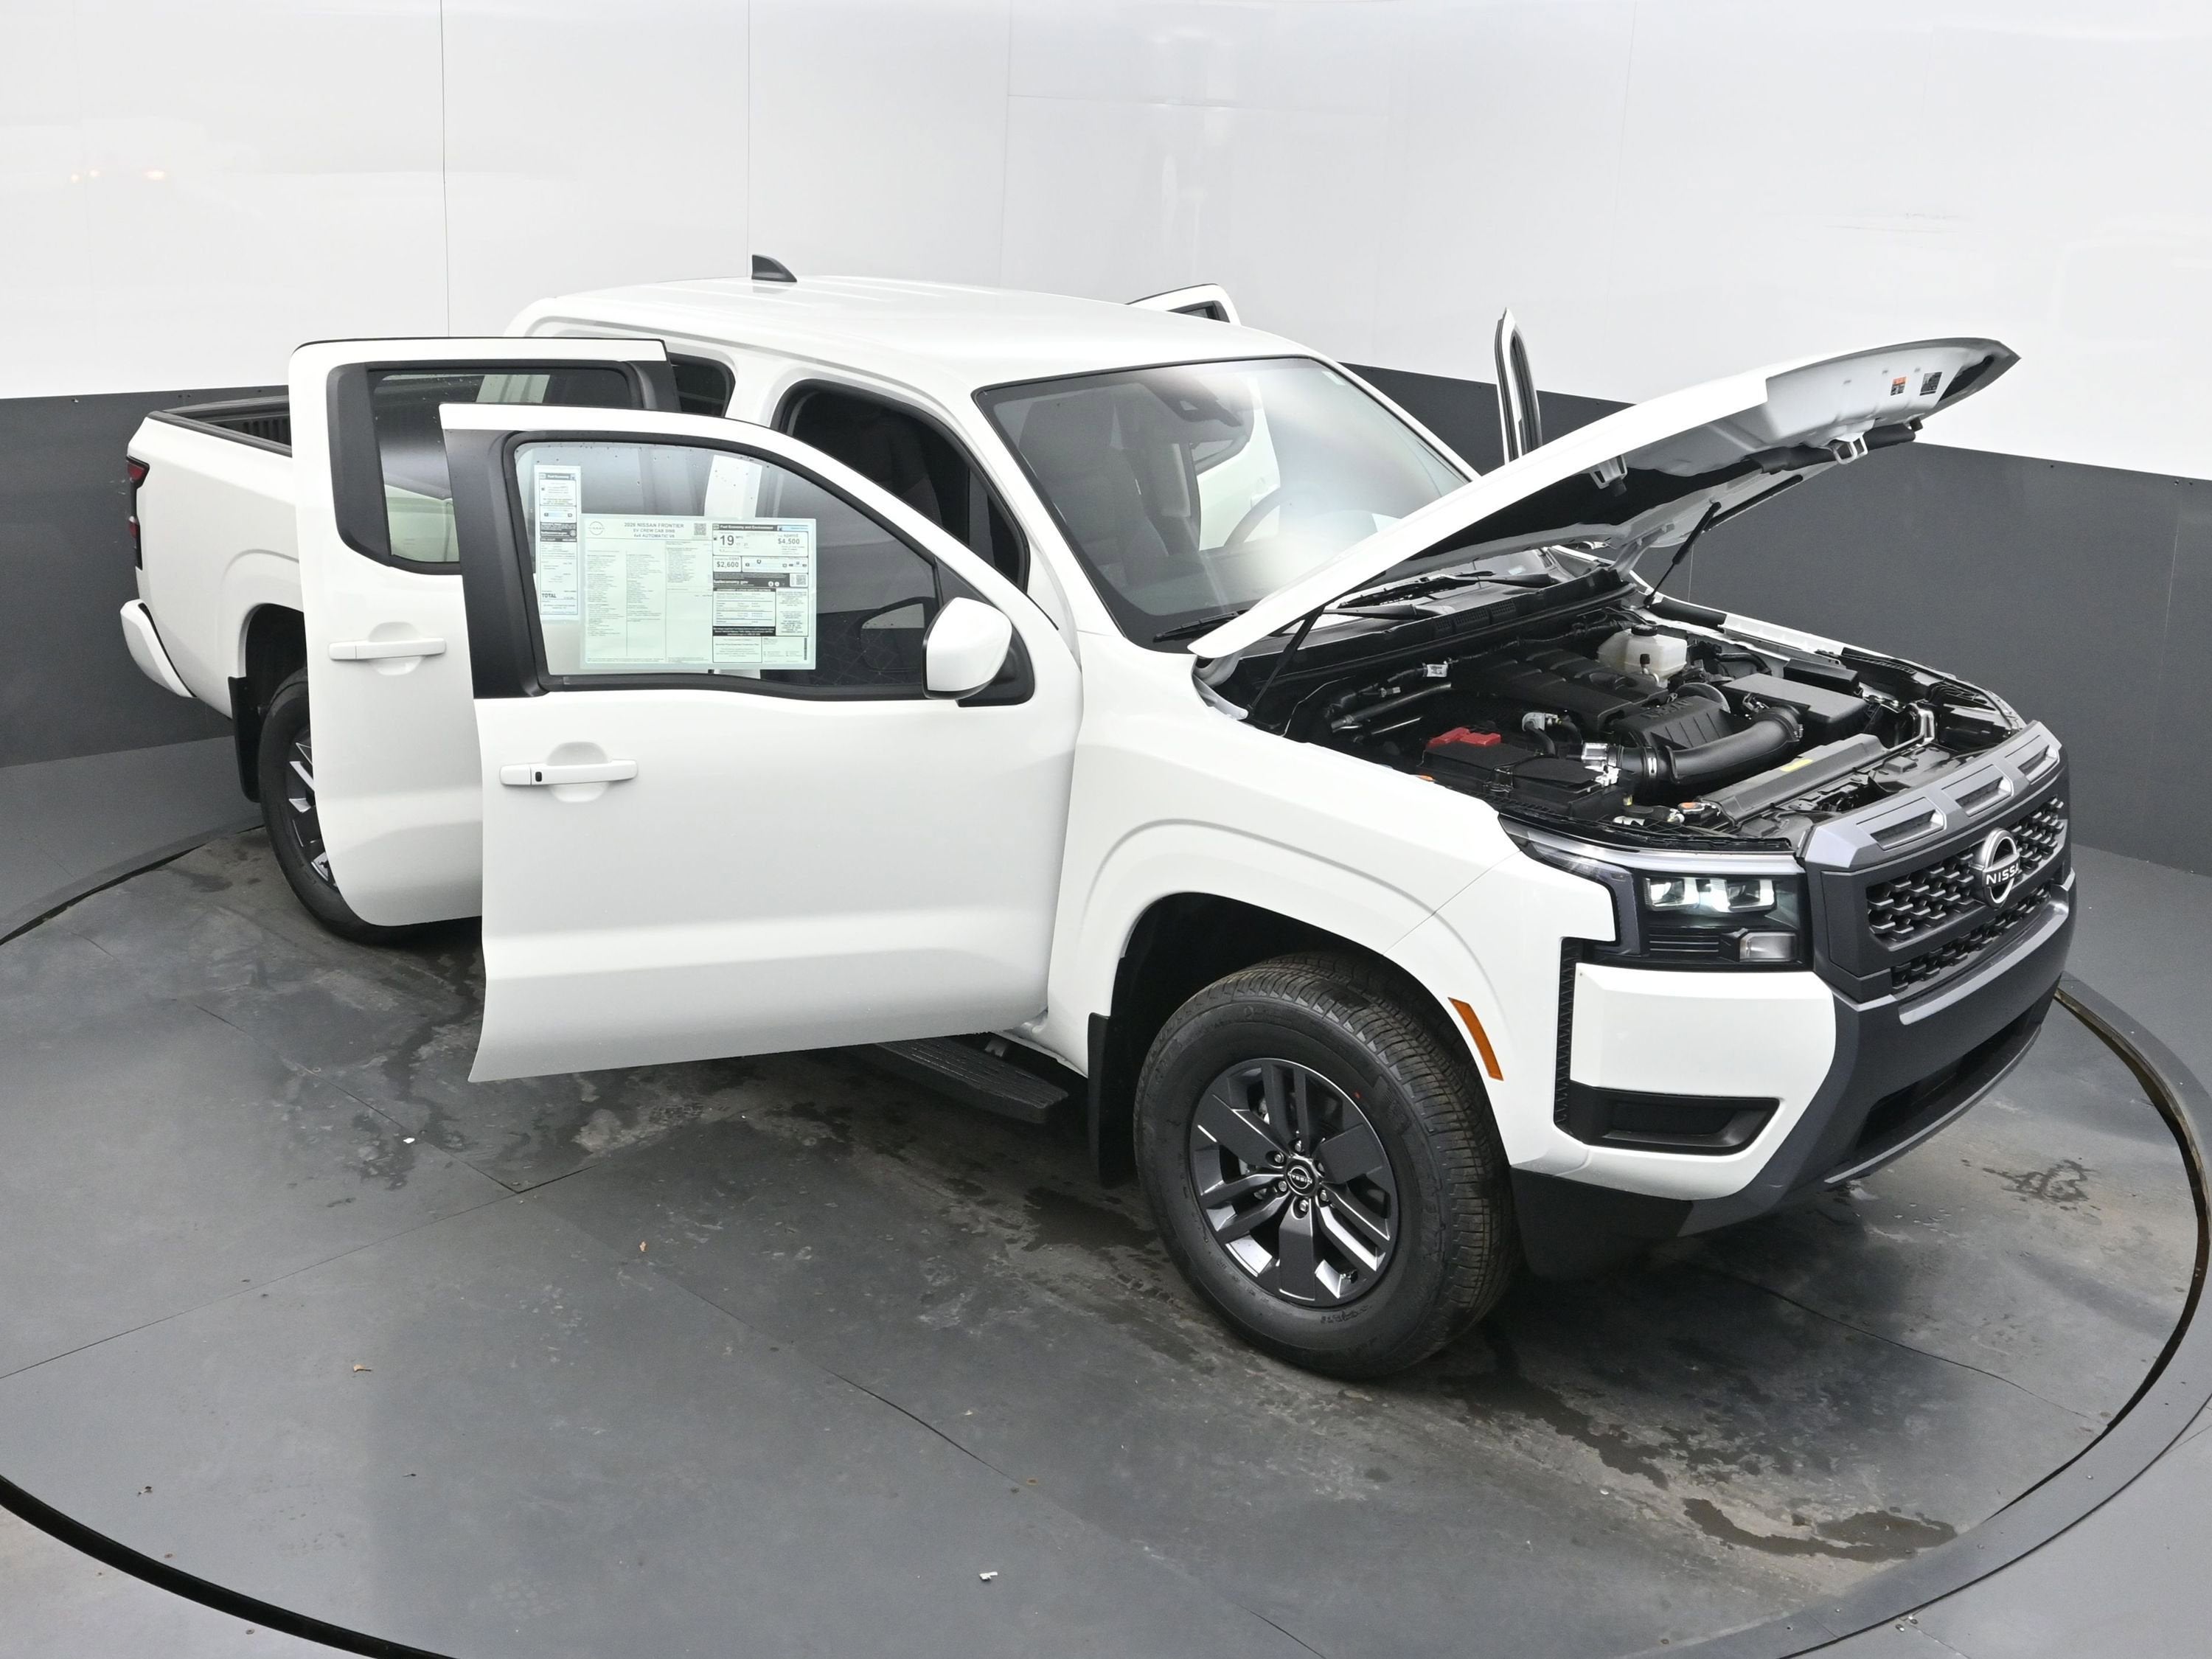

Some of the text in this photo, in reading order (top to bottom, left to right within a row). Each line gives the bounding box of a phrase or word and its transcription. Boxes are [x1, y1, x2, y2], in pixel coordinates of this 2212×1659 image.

[720, 535, 734, 546] 19
[778, 538, 800, 546] $4,500
[1986, 863, 2020, 885] NISSA
